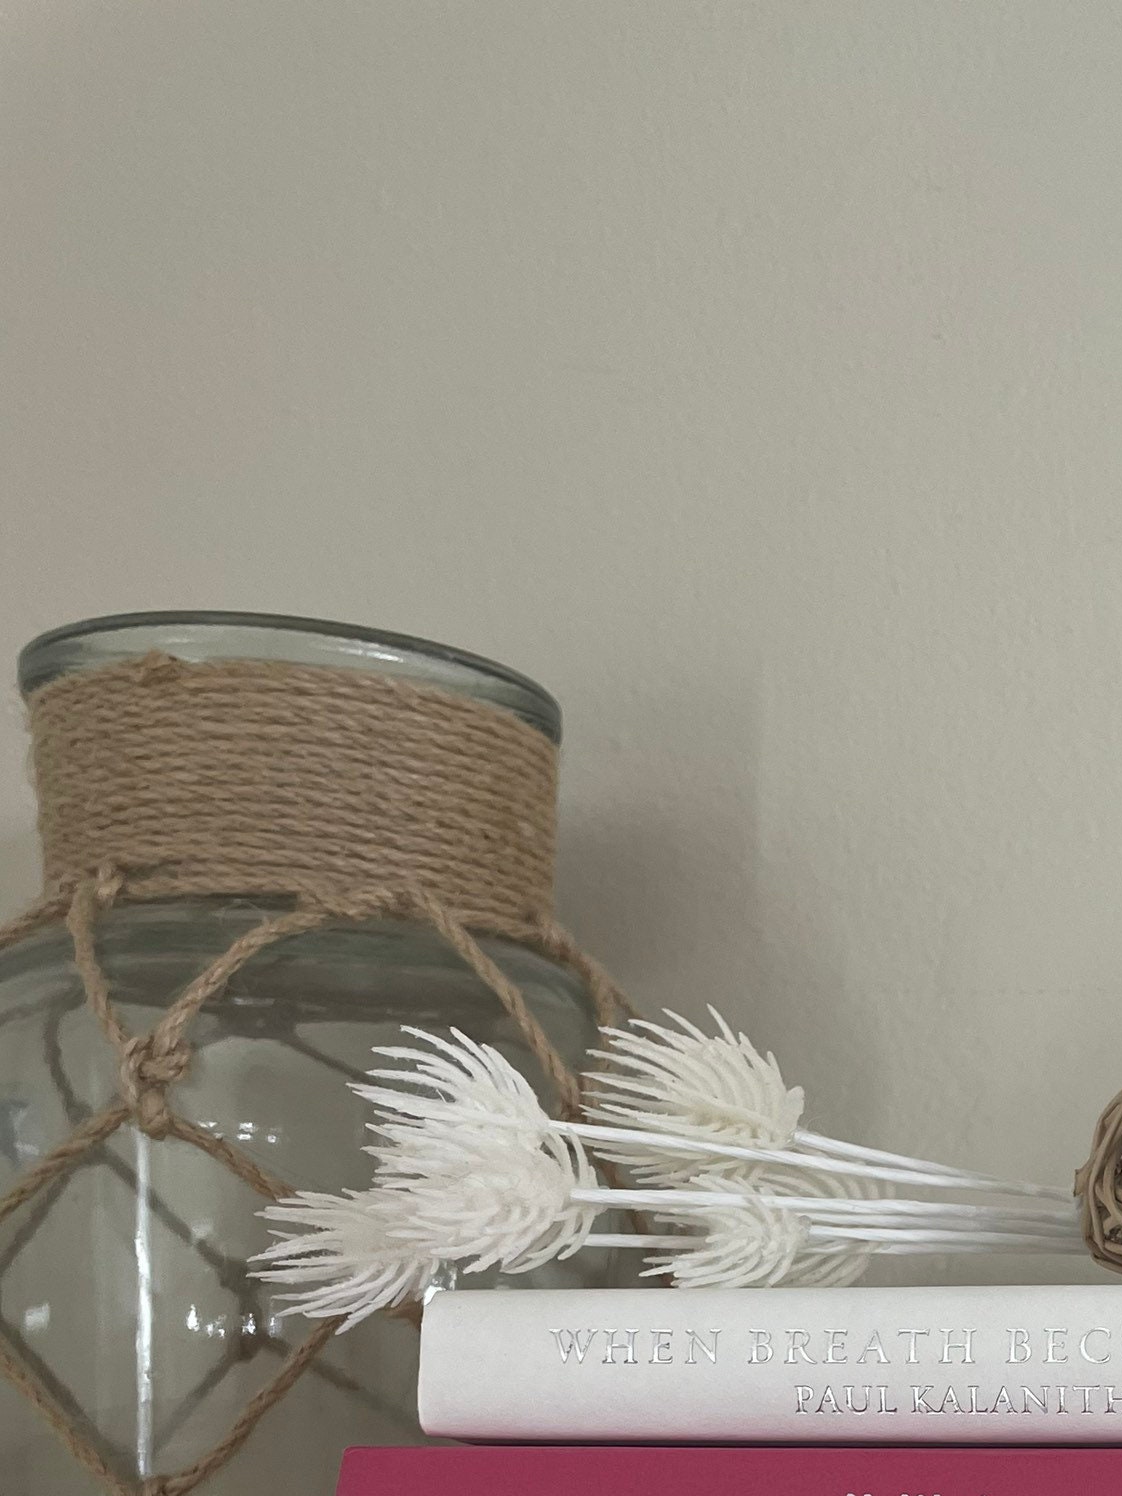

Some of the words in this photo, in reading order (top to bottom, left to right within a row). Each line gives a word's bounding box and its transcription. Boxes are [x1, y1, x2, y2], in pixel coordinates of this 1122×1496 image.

[549, 1327, 722, 1366] WHEN
[748, 1327, 978, 1367] BREATH
[795, 1384, 898, 1417] PAUL
